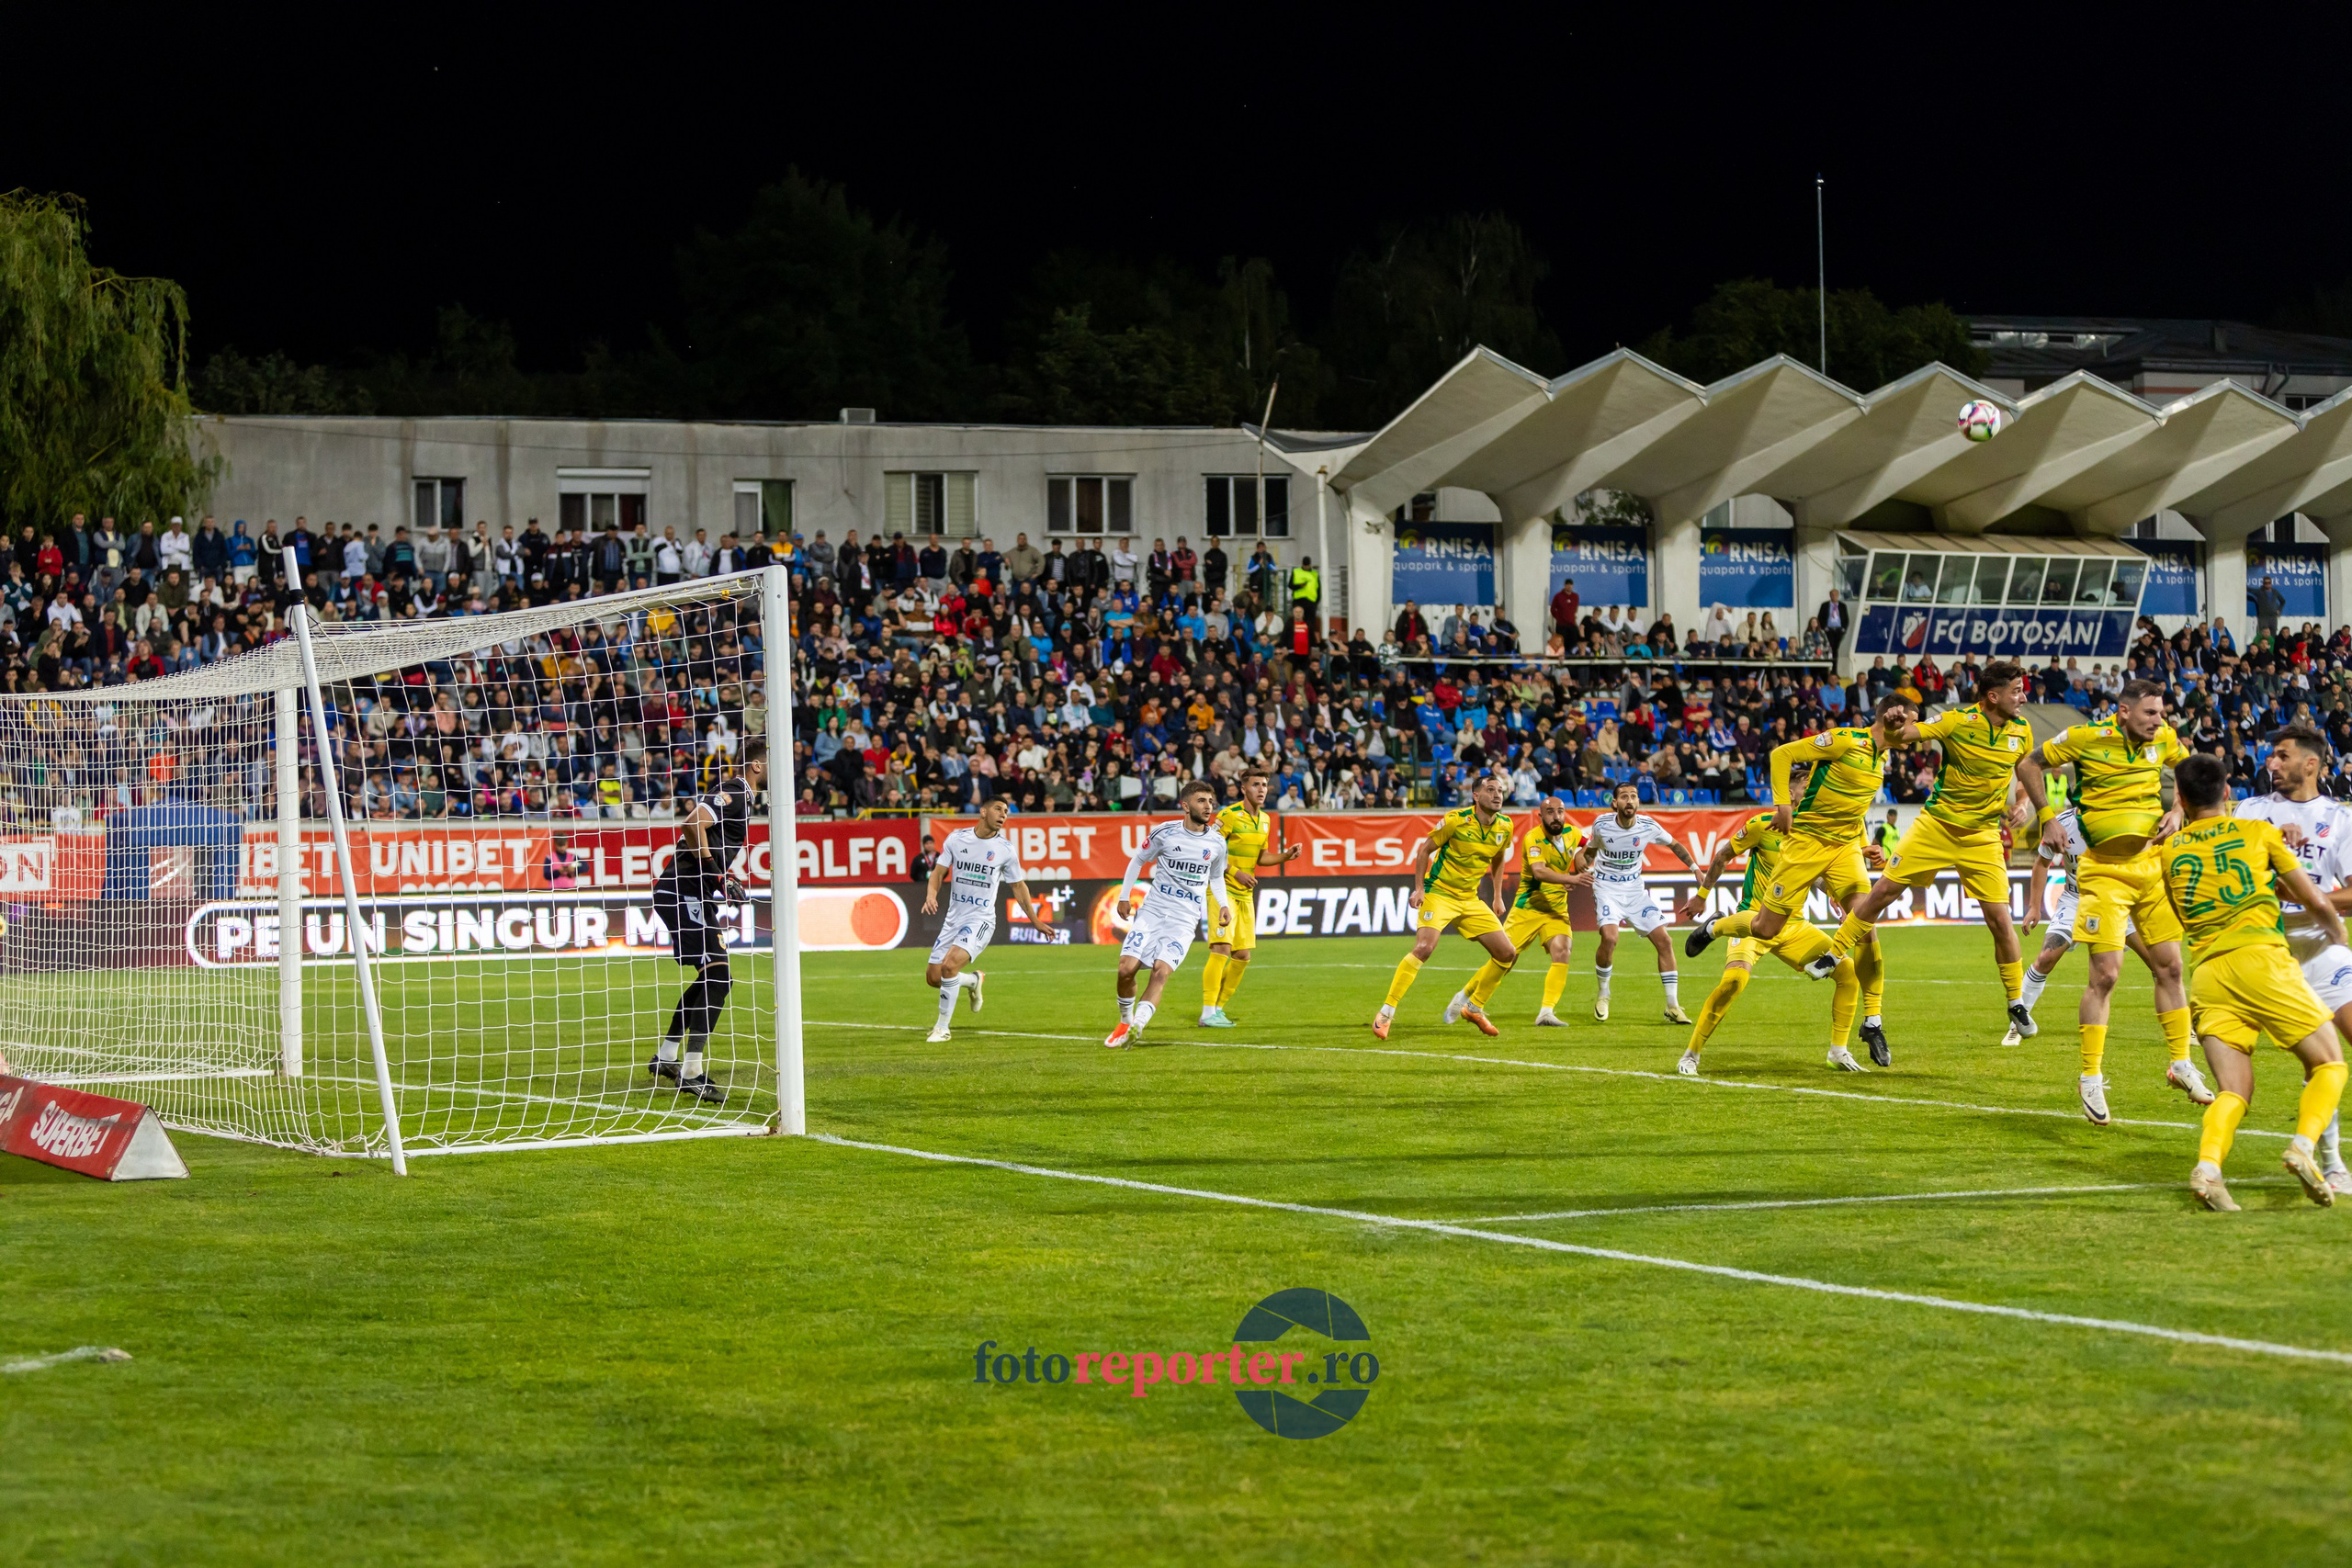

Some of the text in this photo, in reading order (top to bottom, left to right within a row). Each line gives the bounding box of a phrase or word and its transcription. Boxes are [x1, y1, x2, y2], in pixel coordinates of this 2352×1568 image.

[1447, 561, 1454, 570] &
[1459, 562, 1493, 572] sports
[1601, 563, 1608, 573] &
[1613, 564, 1646, 575] sports
[1749, 565, 1756, 574] &
[1760, 565, 1792, 576] sports
[2156, 574, 2163, 584] &
[2166, 575, 2195, 586] sports
[2284, 576, 2290, 586] &
[2294, 577, 2323, 587] sports
[1933, 619, 1966, 644] FC
[2172, 821, 2240, 849] BORNEA
[371, 840, 532, 877] UNIBET
[1604, 850, 1643, 860] UNIBET
[956, 861, 995, 875] UNIBET
[1168, 859, 1209, 874] UNIBET
[2170, 839, 2256, 919] 25
[1601, 905, 1611, 917] 8
[306, 911, 386, 954] UN
[402, 907, 609, 952] SINGUR
[625, 903, 755, 947] MCI
[1127, 931, 1144, 948] 93
[29, 1100, 123, 1157] SUPERBET
